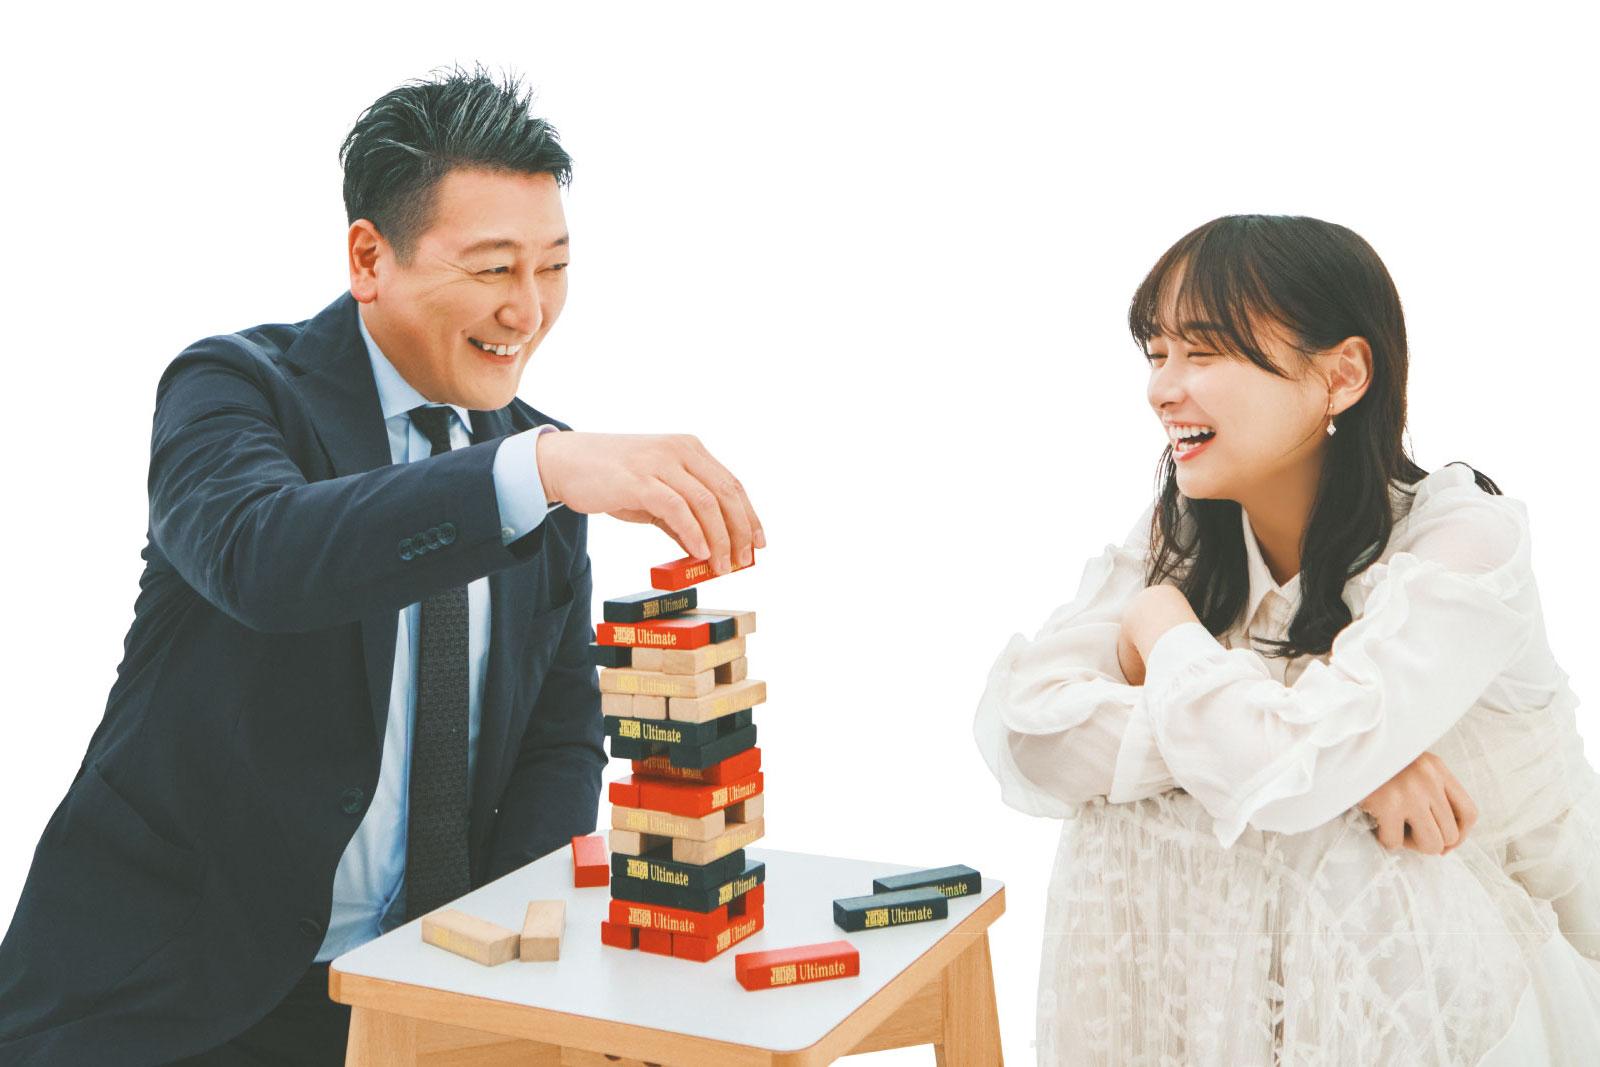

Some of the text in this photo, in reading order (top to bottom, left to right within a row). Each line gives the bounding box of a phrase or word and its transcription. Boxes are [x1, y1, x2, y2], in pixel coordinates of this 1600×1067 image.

[660, 596, 688, 613] Ultimate
[638, 629, 676, 645] Ultimate
[643, 724, 681, 743] Ultimate
[729, 783, 756, 802] Ultimate
[650, 864, 689, 886] Ultimate
[734, 875, 757, 897] Ultimate
[653, 912, 695, 933] Ultimate
[890, 904, 932, 925] Ultimate
[732, 919, 756, 943] Ultimate
[799, 960, 845, 981] Ultimate
